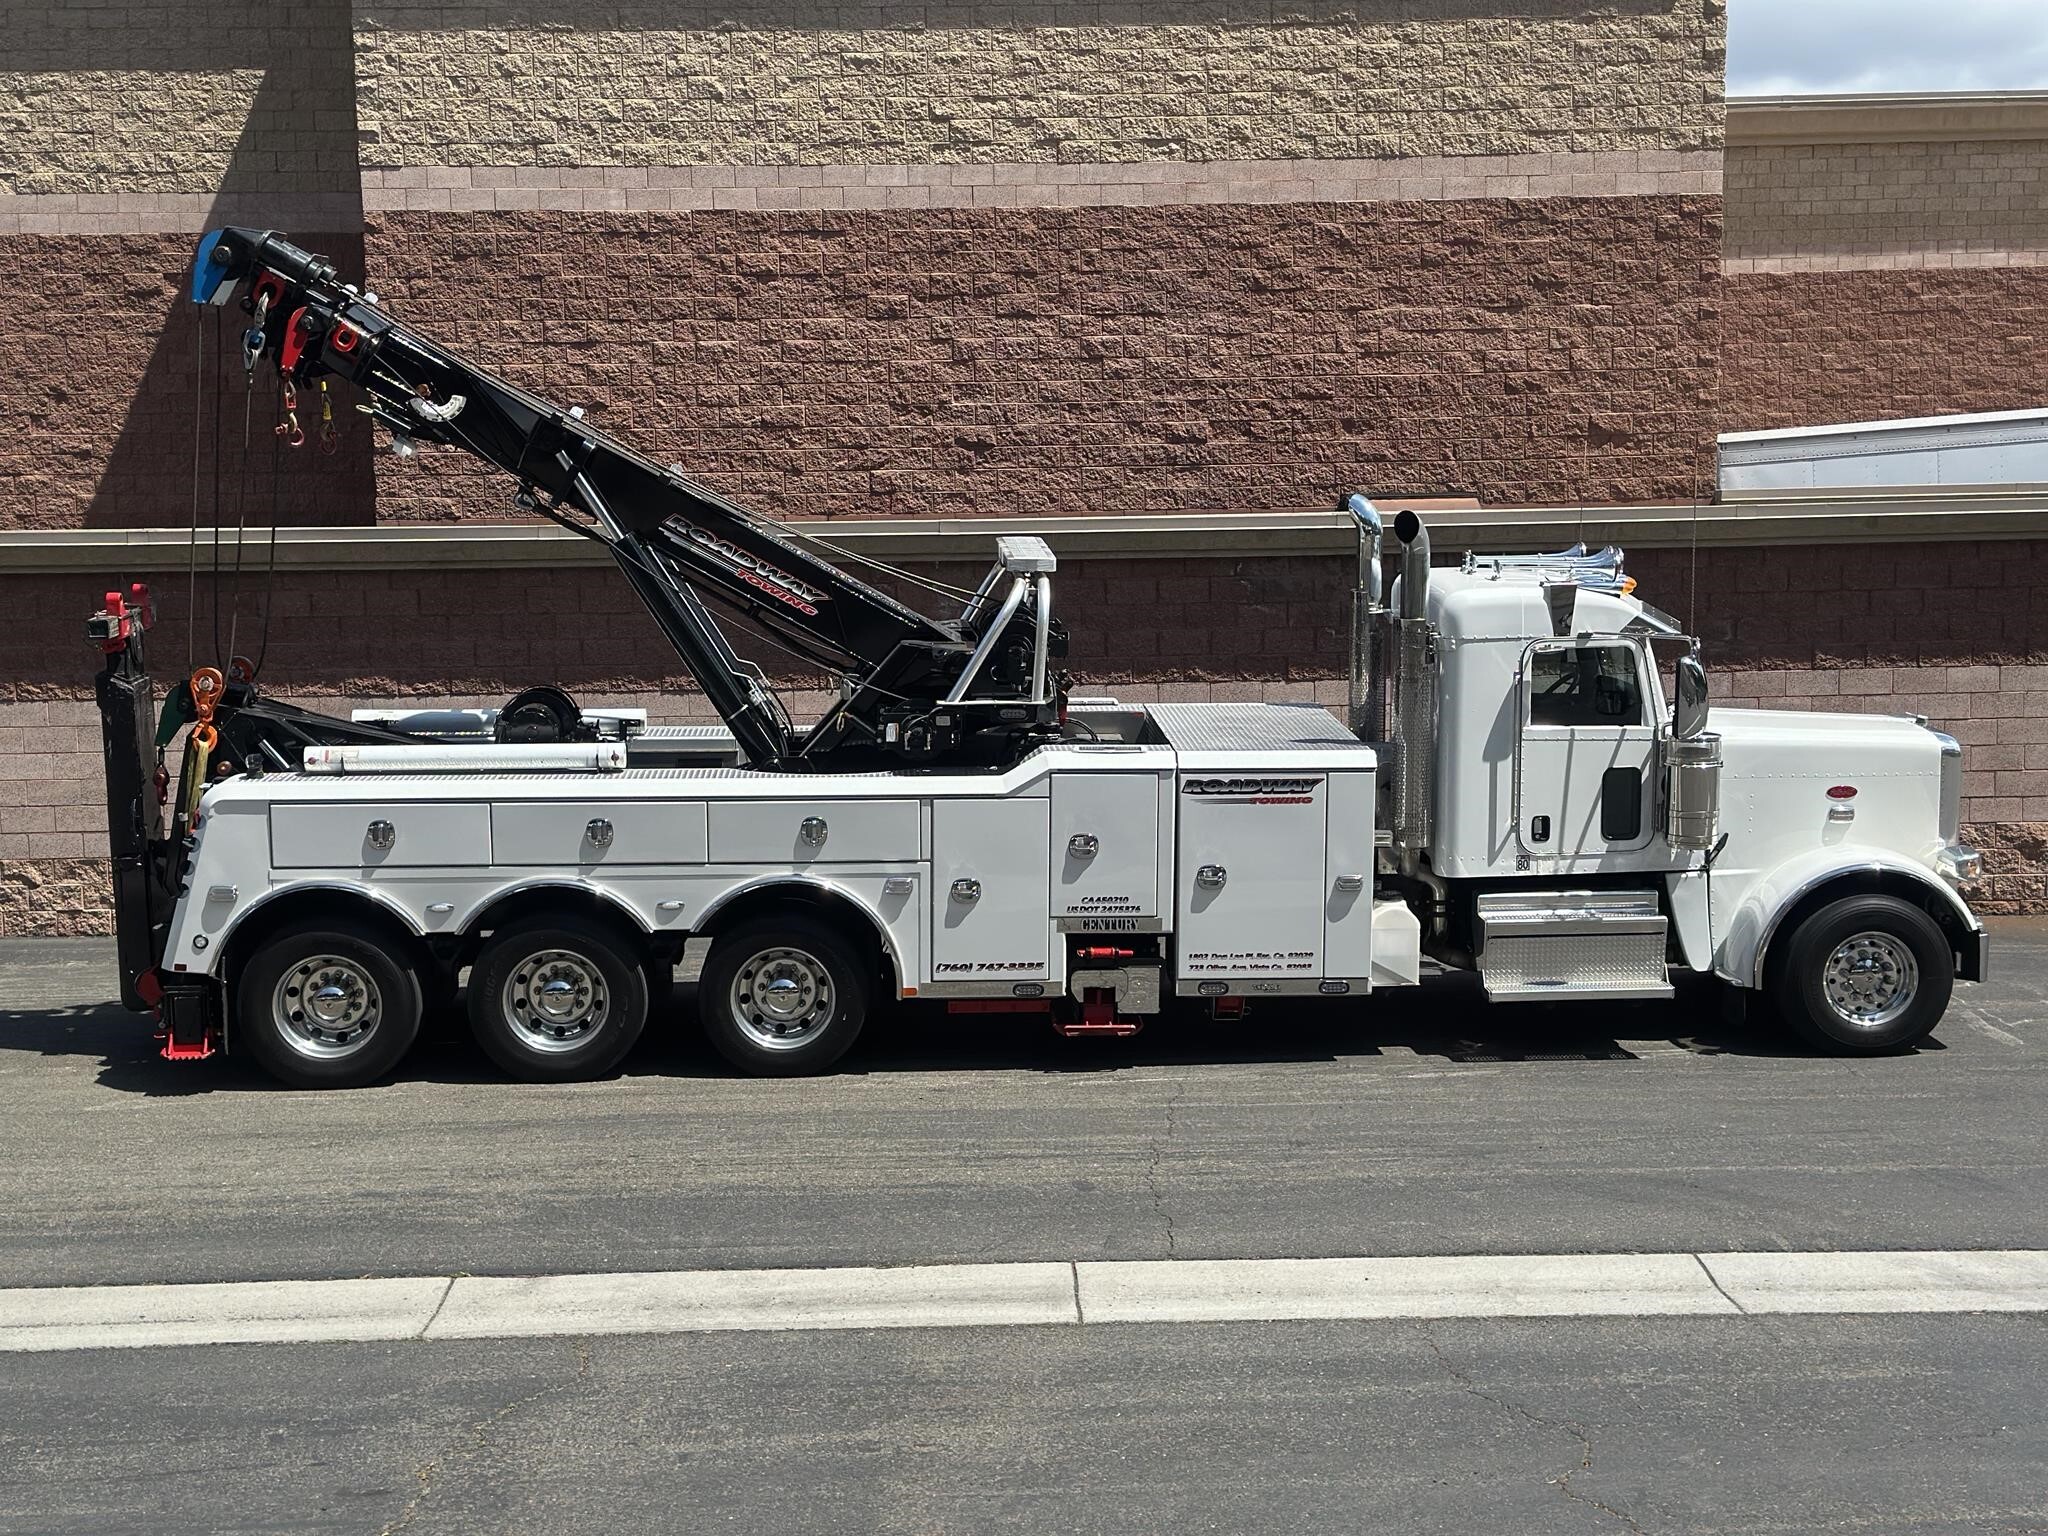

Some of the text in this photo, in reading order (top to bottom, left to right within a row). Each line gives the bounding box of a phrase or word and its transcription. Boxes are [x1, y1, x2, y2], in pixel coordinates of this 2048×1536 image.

[662, 513, 831, 603] ROADWAY
[736, 568, 819, 616] TOWING
[1182, 778, 1325, 794] ROADWAY
[1249, 796, 1314, 805] TOWING
[1517, 859, 1529, 871] 80
[1081, 919, 1140, 932] CENTURY
